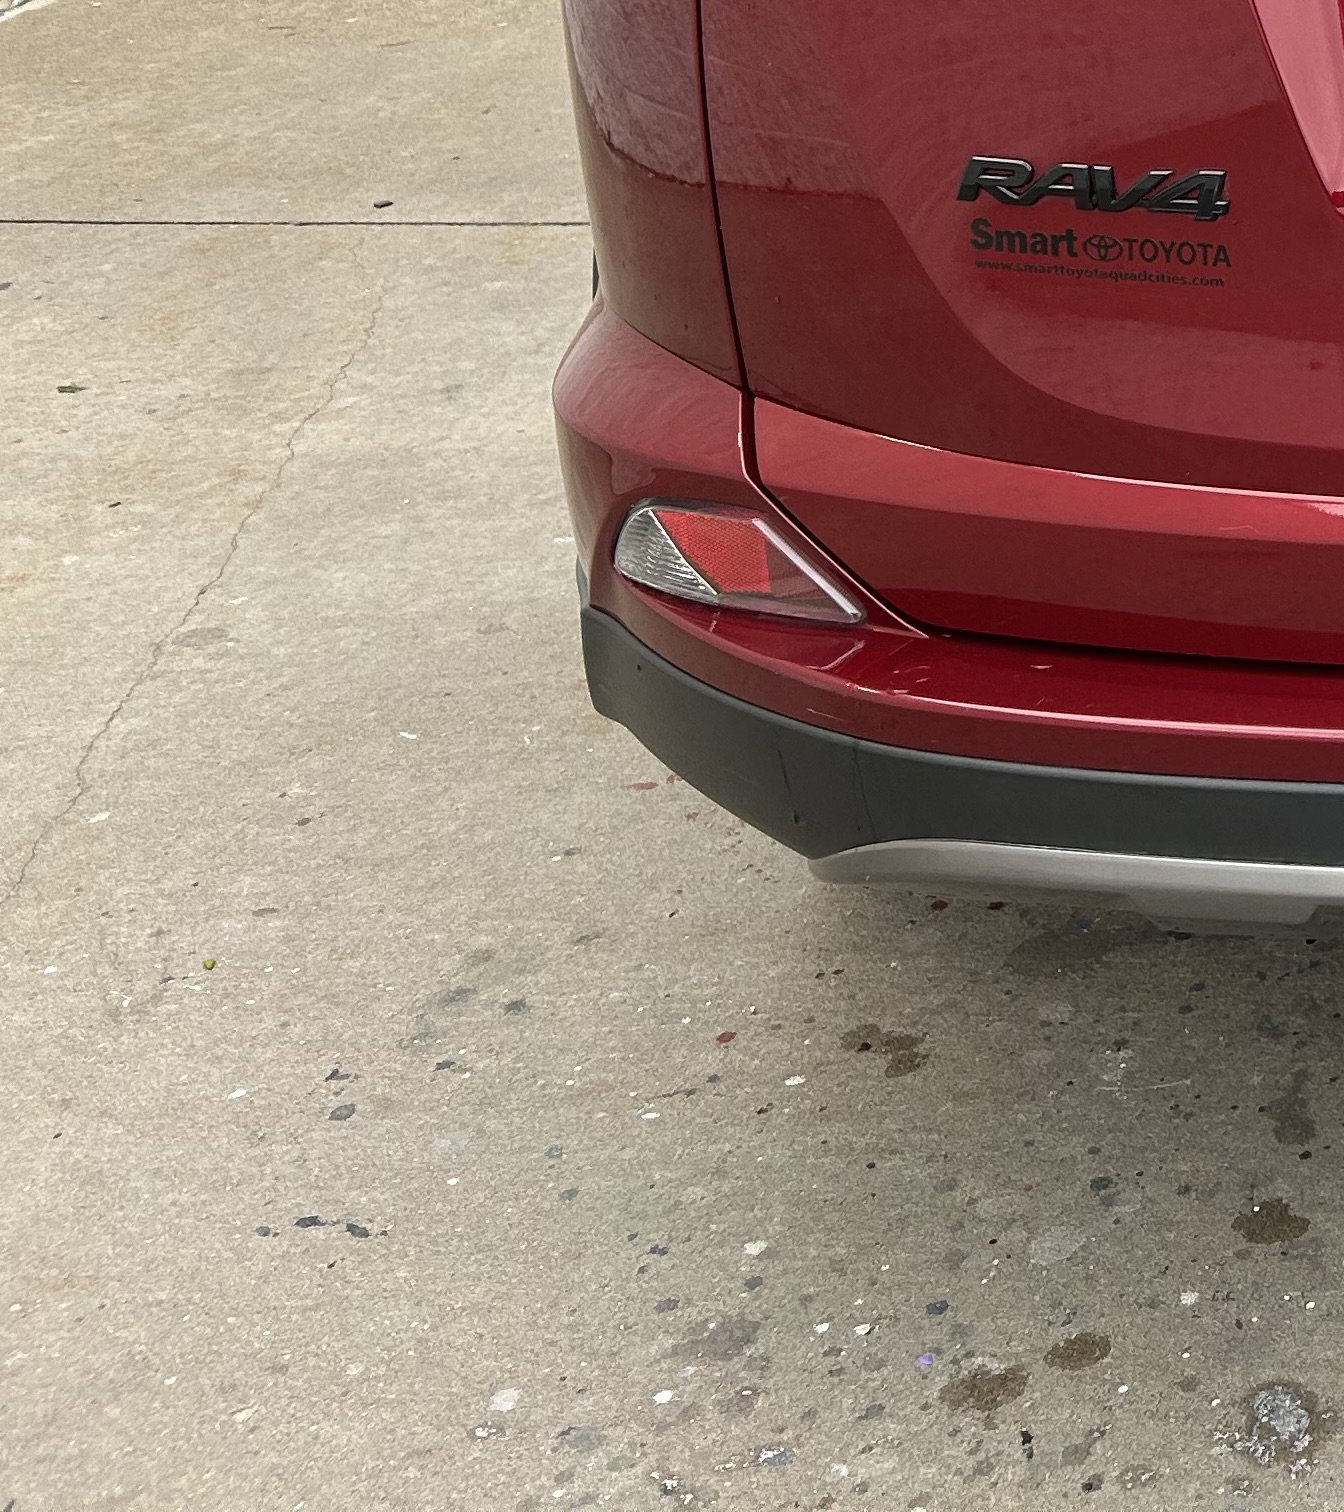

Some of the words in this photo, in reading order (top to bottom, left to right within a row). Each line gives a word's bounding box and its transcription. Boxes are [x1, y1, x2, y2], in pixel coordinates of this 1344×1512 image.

[956, 154, 1231, 221] RAV4
[970, 217, 1079, 258] Smart
[1122, 237, 1232, 268] TOYOTA
[975, 259, 1226, 287] www.smarttoyotaquadcities.com
